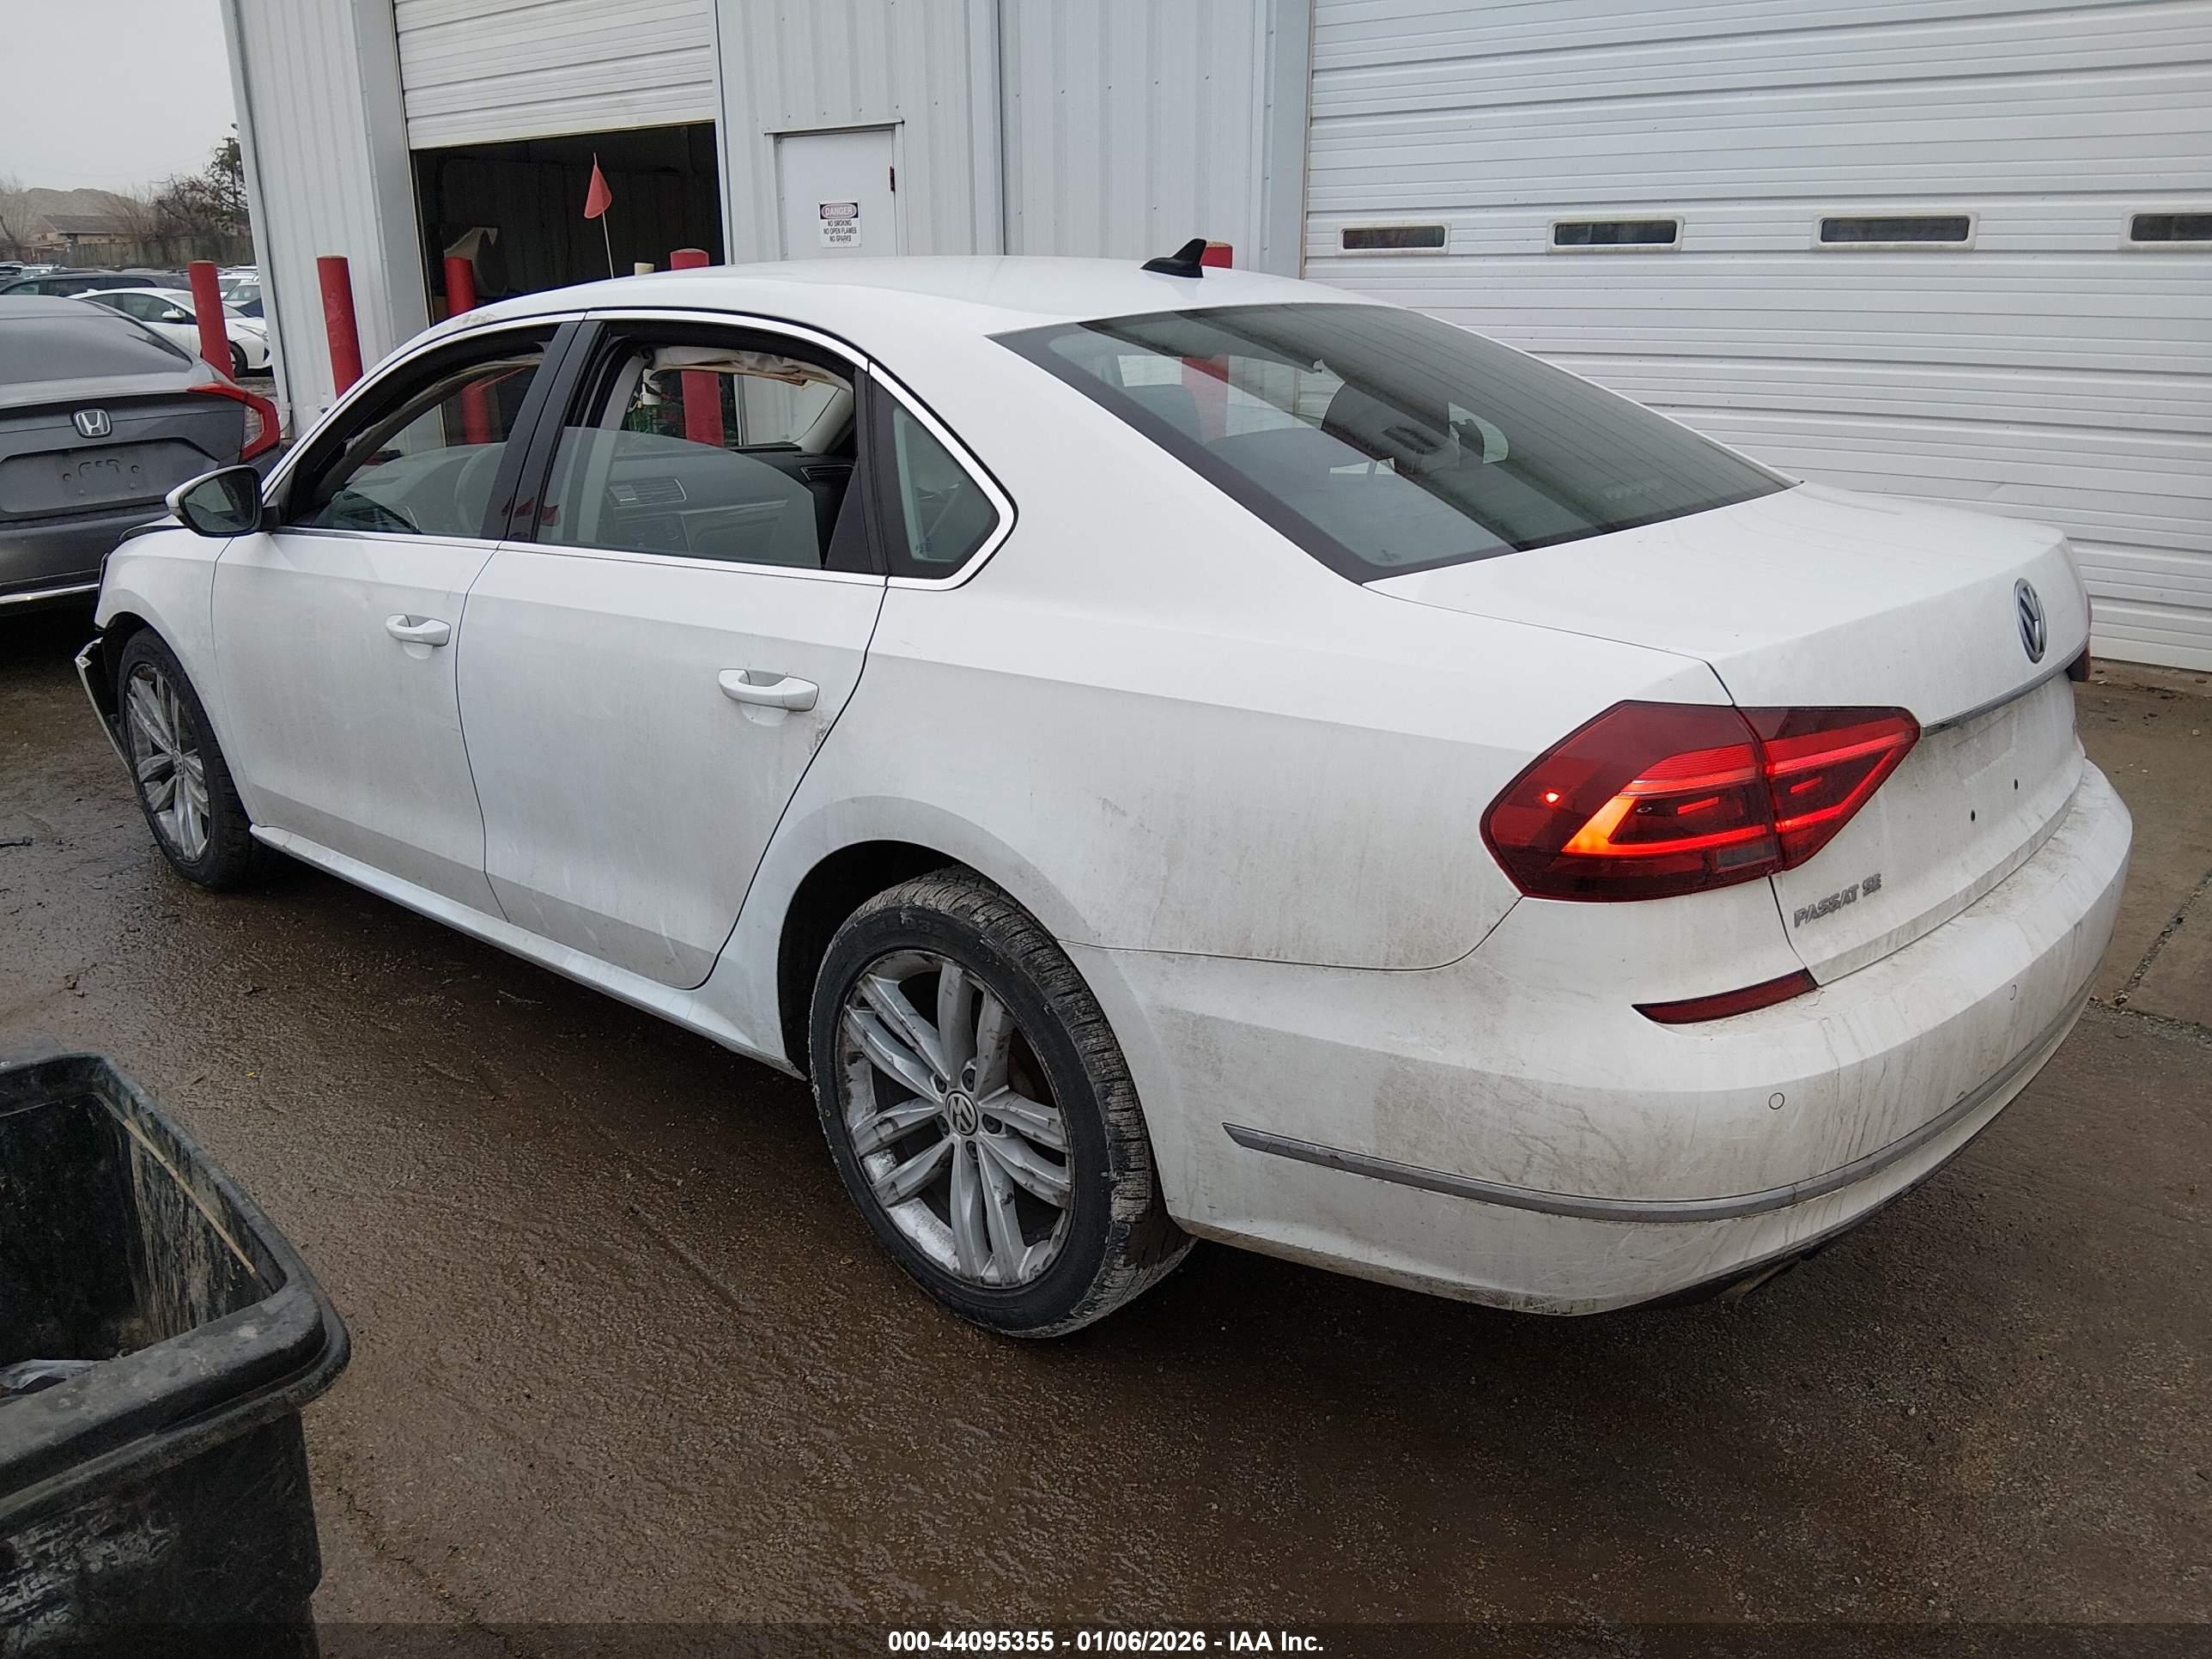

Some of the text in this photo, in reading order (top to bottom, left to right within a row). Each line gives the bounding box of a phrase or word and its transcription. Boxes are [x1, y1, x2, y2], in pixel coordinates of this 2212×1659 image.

[825, 206, 853, 216] DANGER
[1794, 872, 1882, 928] PASSAT SE
